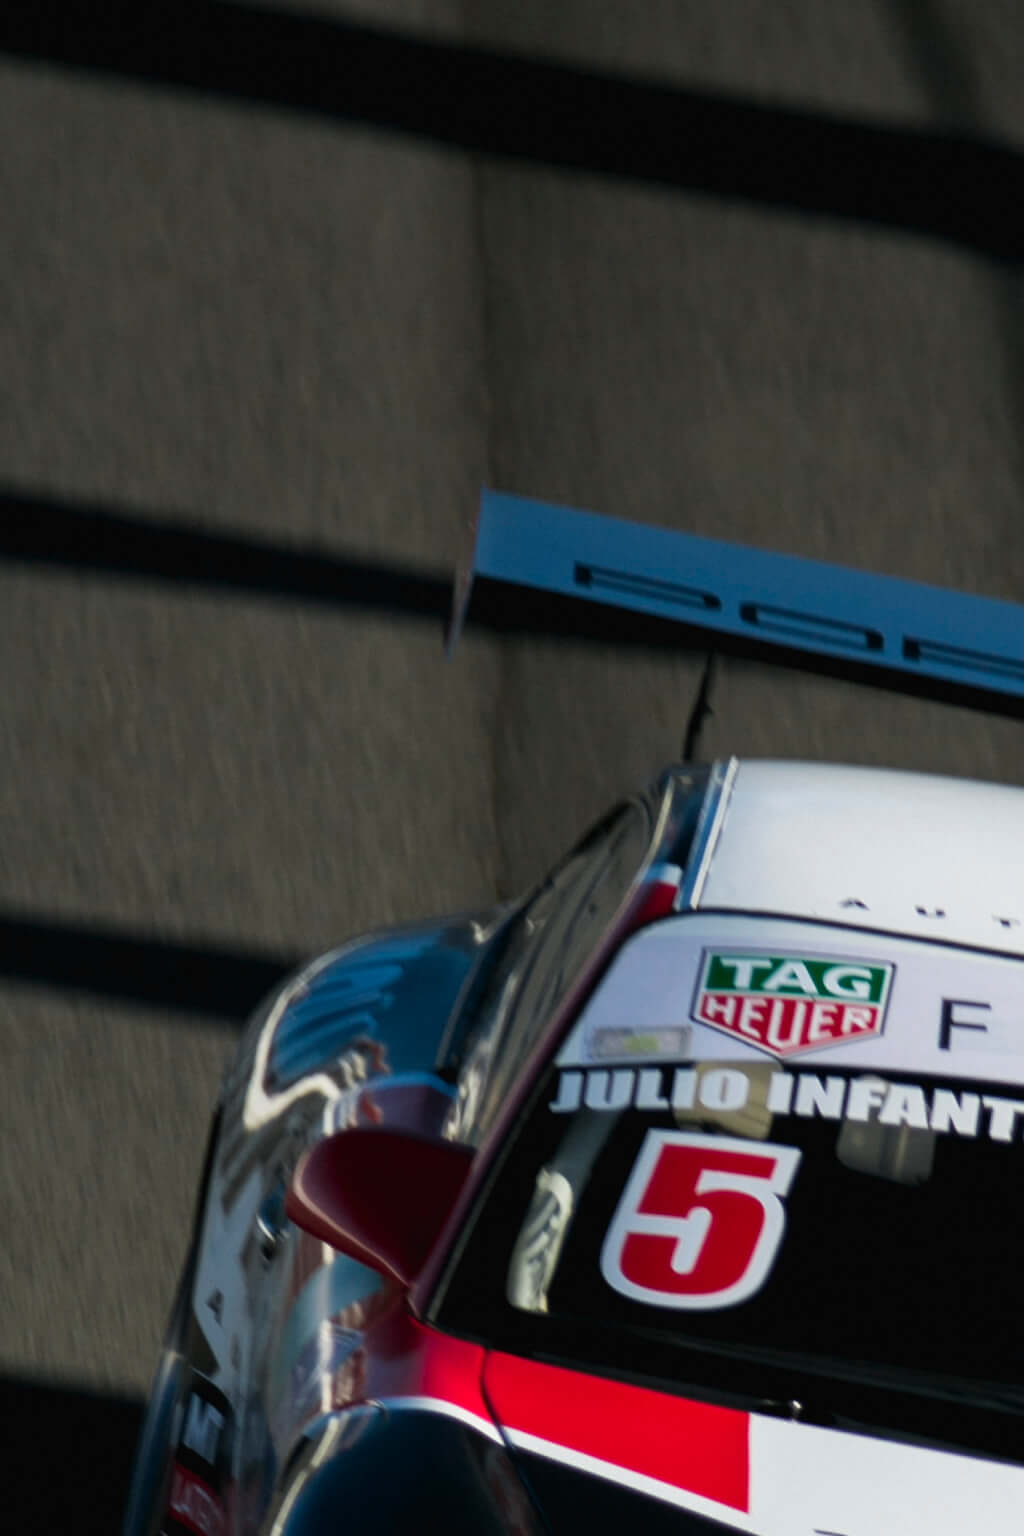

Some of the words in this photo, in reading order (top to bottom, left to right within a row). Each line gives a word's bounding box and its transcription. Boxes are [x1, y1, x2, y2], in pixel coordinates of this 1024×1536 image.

[719, 956, 876, 1001] TAG
[703, 995, 879, 1051] HEUER
[549, 1067, 750, 1113] JULIO
[601, 1128, 801, 1311] 5
